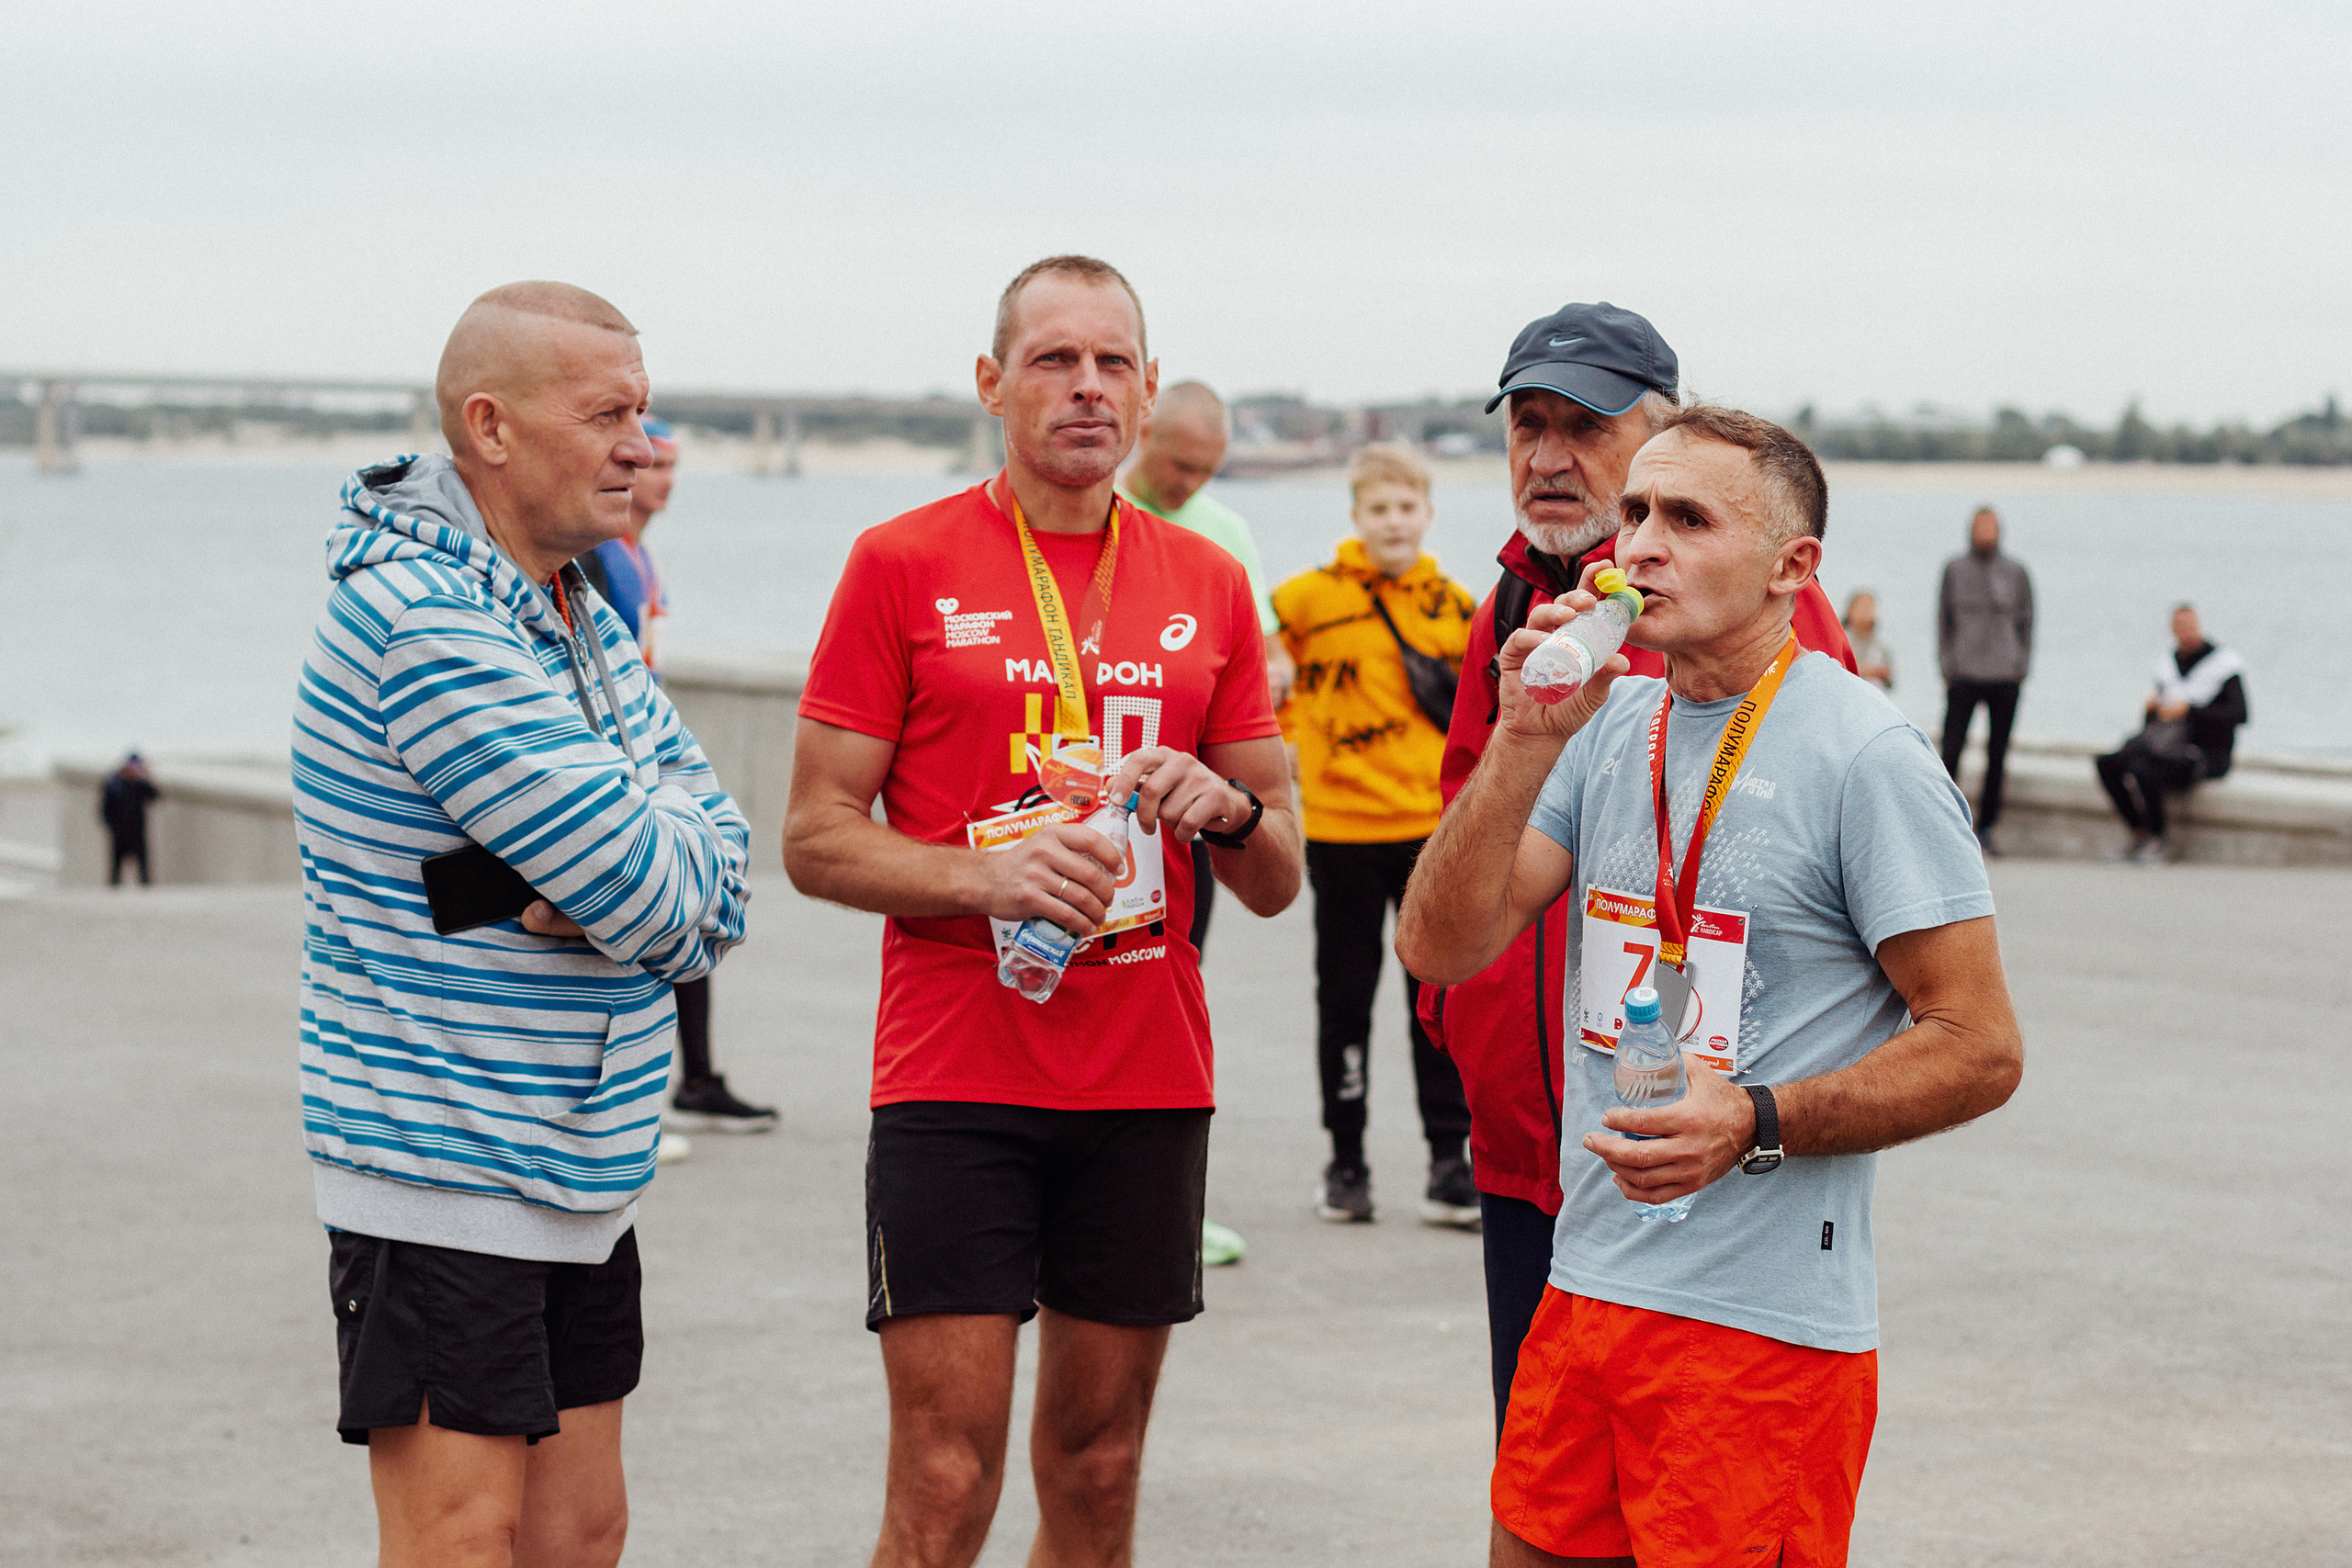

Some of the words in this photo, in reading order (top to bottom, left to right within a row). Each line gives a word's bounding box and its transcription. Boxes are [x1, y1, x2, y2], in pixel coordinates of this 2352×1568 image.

[944, 610, 1012, 624] МОСКОВСКИЙ
[944, 620, 995, 632] МАРАФОН
[945, 628, 989, 639] MOSCOW
[945, 636, 1001, 648] MARATHON
[1048, 628, 1077, 699] ГАНДИКАП
[1704, 700, 1758, 817] ПОЛУМАРАФО
[986, 808, 1080, 839] ПОЛУМАРАФОН
[1596, 898, 1657, 919] ПОЛУМАРАФ
[1108, 945, 1166, 965] MOSCOW
[1744, 1545, 1768, 1553] JOSS
